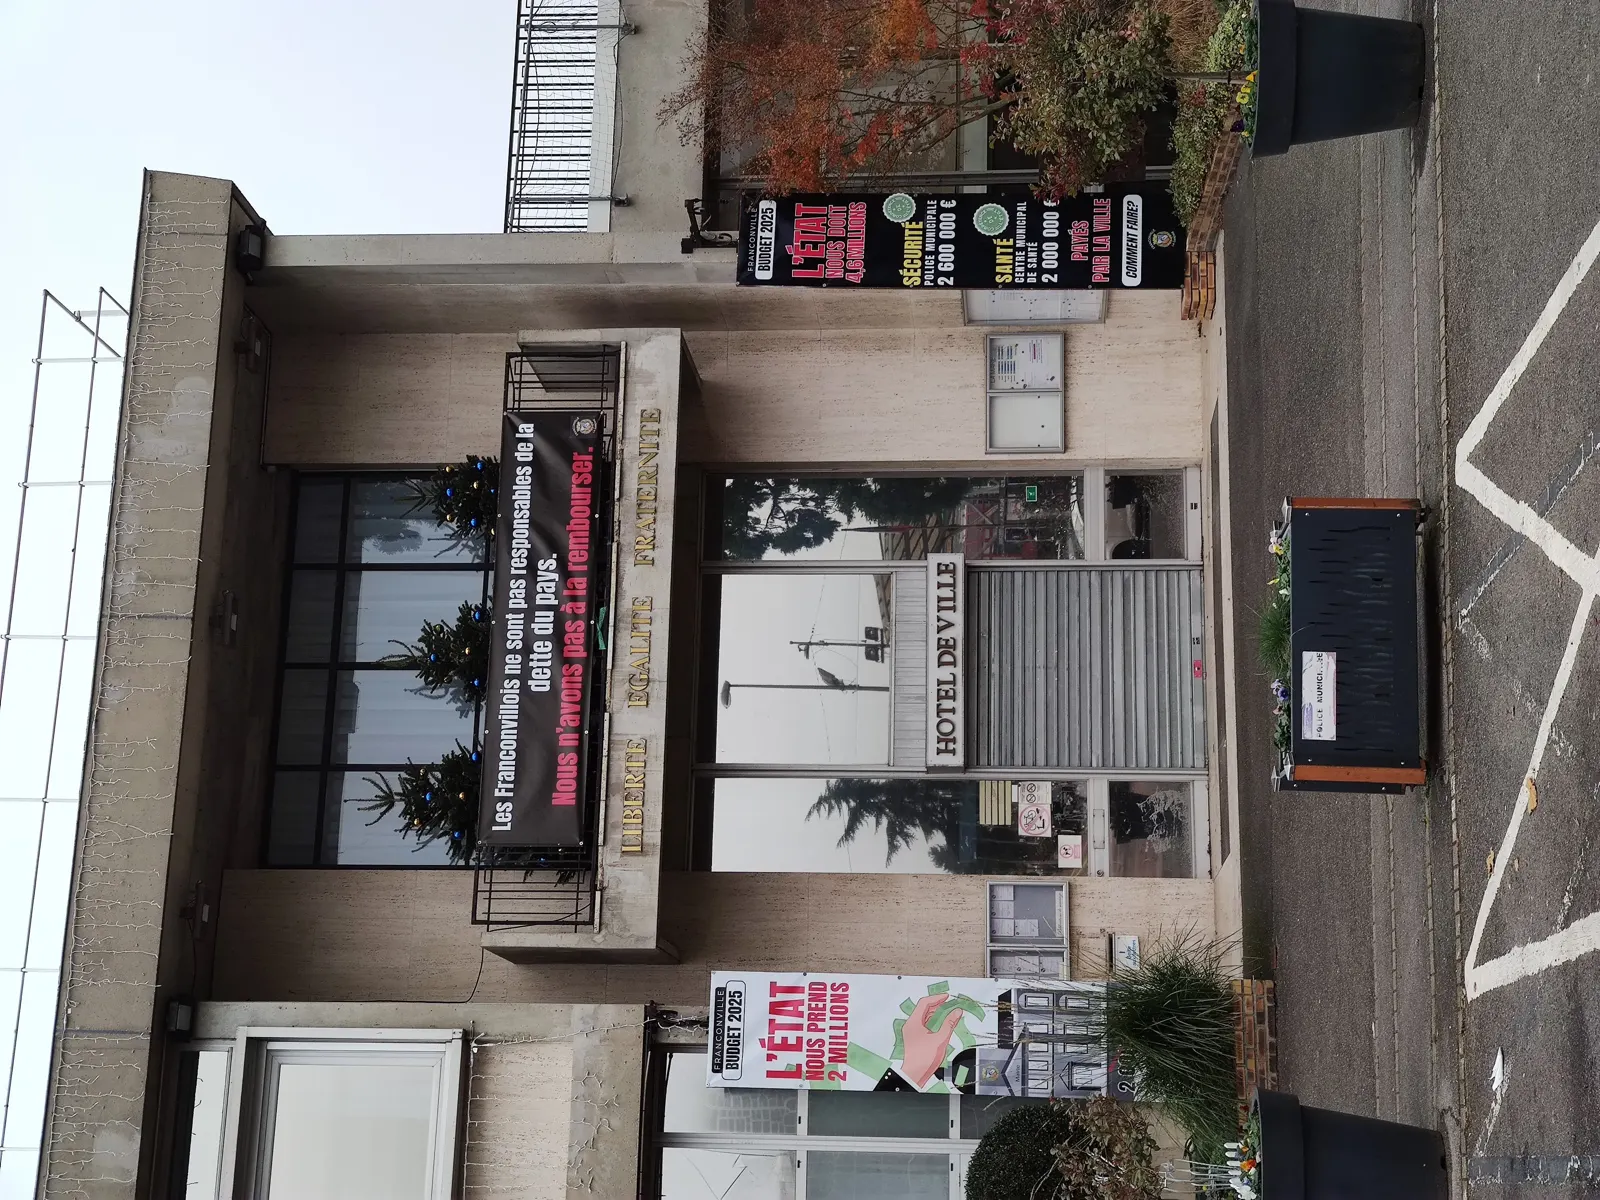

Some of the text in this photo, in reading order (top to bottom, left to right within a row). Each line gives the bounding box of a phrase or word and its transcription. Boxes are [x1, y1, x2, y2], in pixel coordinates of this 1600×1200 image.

[747, 208, 758, 272] FRANCONVILLE
[757, 207, 774, 271] BUDGET 2025
[784, 202, 828, 278] L'ÉTAT
[825, 204, 847, 278] NOUS DOIT
[898, 221, 924, 286] SÉCURITÉ
[924, 199, 937, 286] POLICE MUNICIPALE
[937, 199, 957, 286] 2 600 000 €
[992, 238, 1014, 283] SANTÉ
[1014, 201, 1027, 283] CENTRE MUNICIPAL
[1025, 241, 1038, 283] DE SANTÉ
[1041, 241, 1059, 269] 000
[1042, 211, 1060, 238] 000
[1067, 220, 1090, 261] PAYÉS
[1091, 198, 1111, 283] PAR LA VILLE
[1125, 200, 1139, 279] COMMENT FAIRE?
[1041, 273, 1058, 283] 2
[632, 408, 661, 567] FRATERNITE
[491, 423, 535, 831] Les Franconvillois ne sont pas responsables de la
[528, 553, 559, 692] dette du pays.
[551, 446, 595, 806] Nous n'avons pas à la rembourser.
[626, 595, 652, 708] EGALITE
[936, 561, 957, 756] HOTEL DE VILLE
[620, 738, 647, 854] LIBERTE
[713, 990, 725, 1070] FRANCONVILLE
[725, 990, 743, 1070] BUDGET 2025
[758, 981, 806, 1079] L'ÉTAT
[805, 981, 828, 1081] NOUS PREND
[828, 982, 850, 1082] 2 MILLIONS
